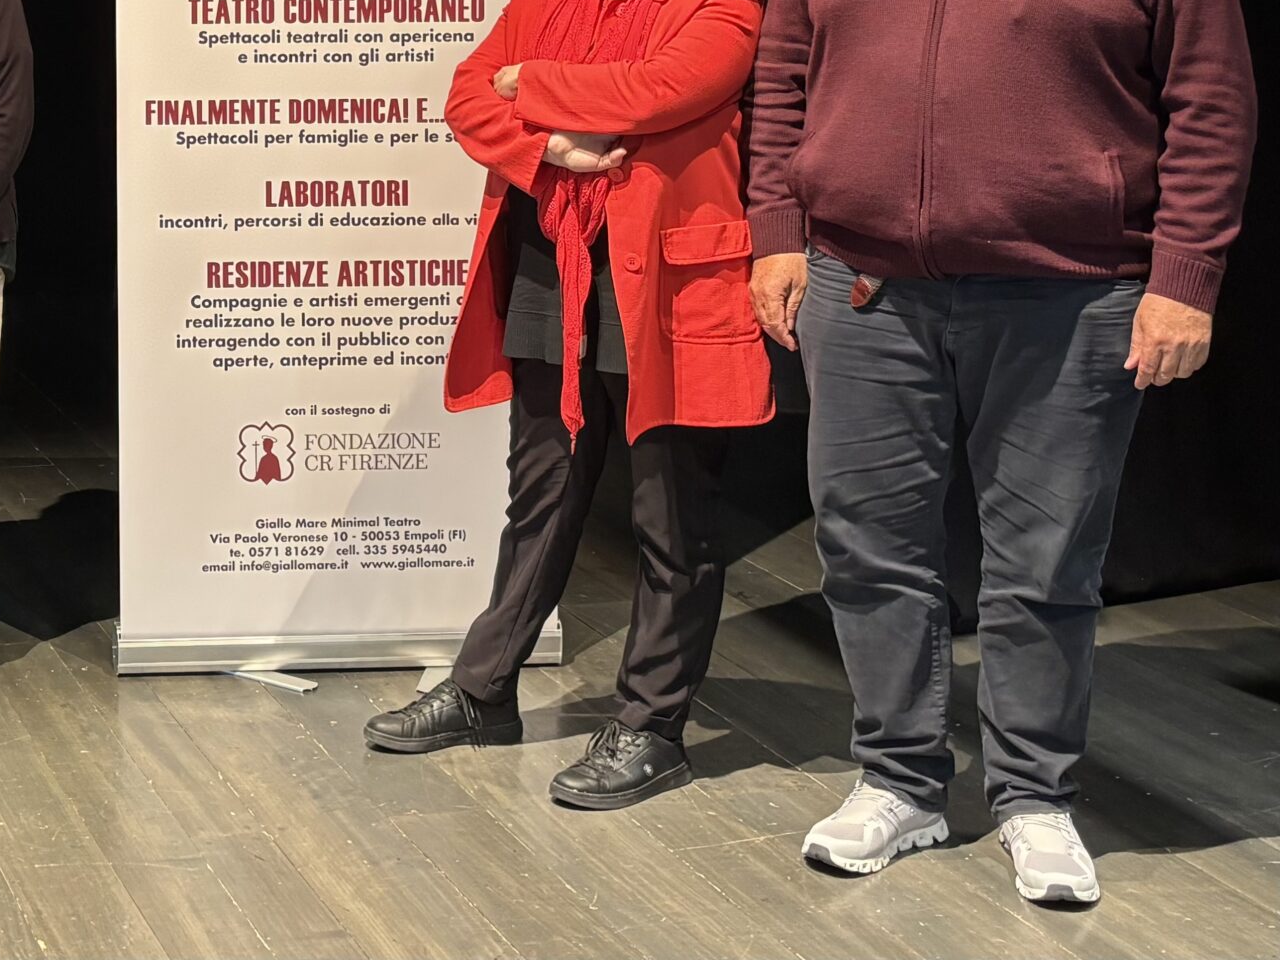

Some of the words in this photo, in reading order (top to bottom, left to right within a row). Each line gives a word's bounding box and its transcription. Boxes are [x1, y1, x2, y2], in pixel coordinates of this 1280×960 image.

[199, 29, 280, 48] Spettacoli
[287, 29, 348, 43] teatrali
[354, 33, 383, 43] con
[390, 28, 474, 46] apericena
[238, 54, 247, 63] e
[254, 49, 317, 63] incontri
[324, 53, 352, 62] con
[359, 48, 379, 66] gli
[386, 48, 434, 62] artisti
[146, 99, 280, 125] FINALMENTE
[289, 98, 408, 124] DOMENICA!
[176, 130, 258, 148] Spettacoli
[265, 134, 293, 148] per
[299, 129, 368, 147] famiglie
[374, 134, 383, 143] e
[391, 134, 418, 147] per
[425, 128, 438, 142] le
[266, 180, 408, 207] LABORATORI
[159, 214, 228, 229] incontri,
[235, 213, 301, 231] percorsi
[308, 212, 323, 226] di
[330, 212, 426, 226] educazione
[433, 213, 459, 225] alla
[207, 261, 328, 288] RESIDENZE
[337, 260, 467, 287] ARTISTICHE
[191, 294, 287, 312] Compagnie
[294, 298, 303, 307] e
[310, 293, 357, 307] artisti
[364, 292, 450, 310] emergenti
[186, 314, 274, 328] realizzano
[281, 313, 295, 327] le
[302, 313, 334, 326] loro
[341, 317, 393, 326] nuove
[399, 312, 457, 329] produz
[177, 333, 280, 351] interagendo
[286, 337, 315, 346] con
[322, 332, 330, 346] il
[338, 331, 409, 350] pubblico
[416, 336, 444, 345] con
[213, 355, 273, 371] aperte,
[280, 352, 367, 370] anteprime
[374, 351, 394, 365] ed
[401, 352, 448, 365] incon
[311, 405, 317, 415] il
[322, 406, 375, 417] sostegno
[379, 404, 390, 414] di
[305, 433, 440, 450] FONDAZIONE
[305, 455, 333, 471] CR
[338, 453, 427, 470] FIRENZE
[256, 518, 291, 529] Giallo
[296, 519, 327, 528] Mare
[331, 516, 379, 527] Minimal
[383, 517, 420, 526] Teatro
[210, 534, 230, 543] Via
[235, 533, 268, 543] Paolo
[273, 533, 328, 542] Veronese
[334, 532, 348, 541] 10
[361, 531, 400, 541] 50053
[405, 529, 444, 543] Empoli
[449, 530, 466, 541] (FI)
[230, 549, 244, 557] te.
[249, 547, 278, 557] 0571
[285, 546, 324, 556] 81629
[336, 545, 359, 555] cell.
[364, 545, 387, 555] 335
[392, 542, 447, 554] 5945440
[202, 561, 235, 572] email
[240, 559, 348, 573] info@giallomare.it
[361, 557, 474, 570] www.giallomare.it
